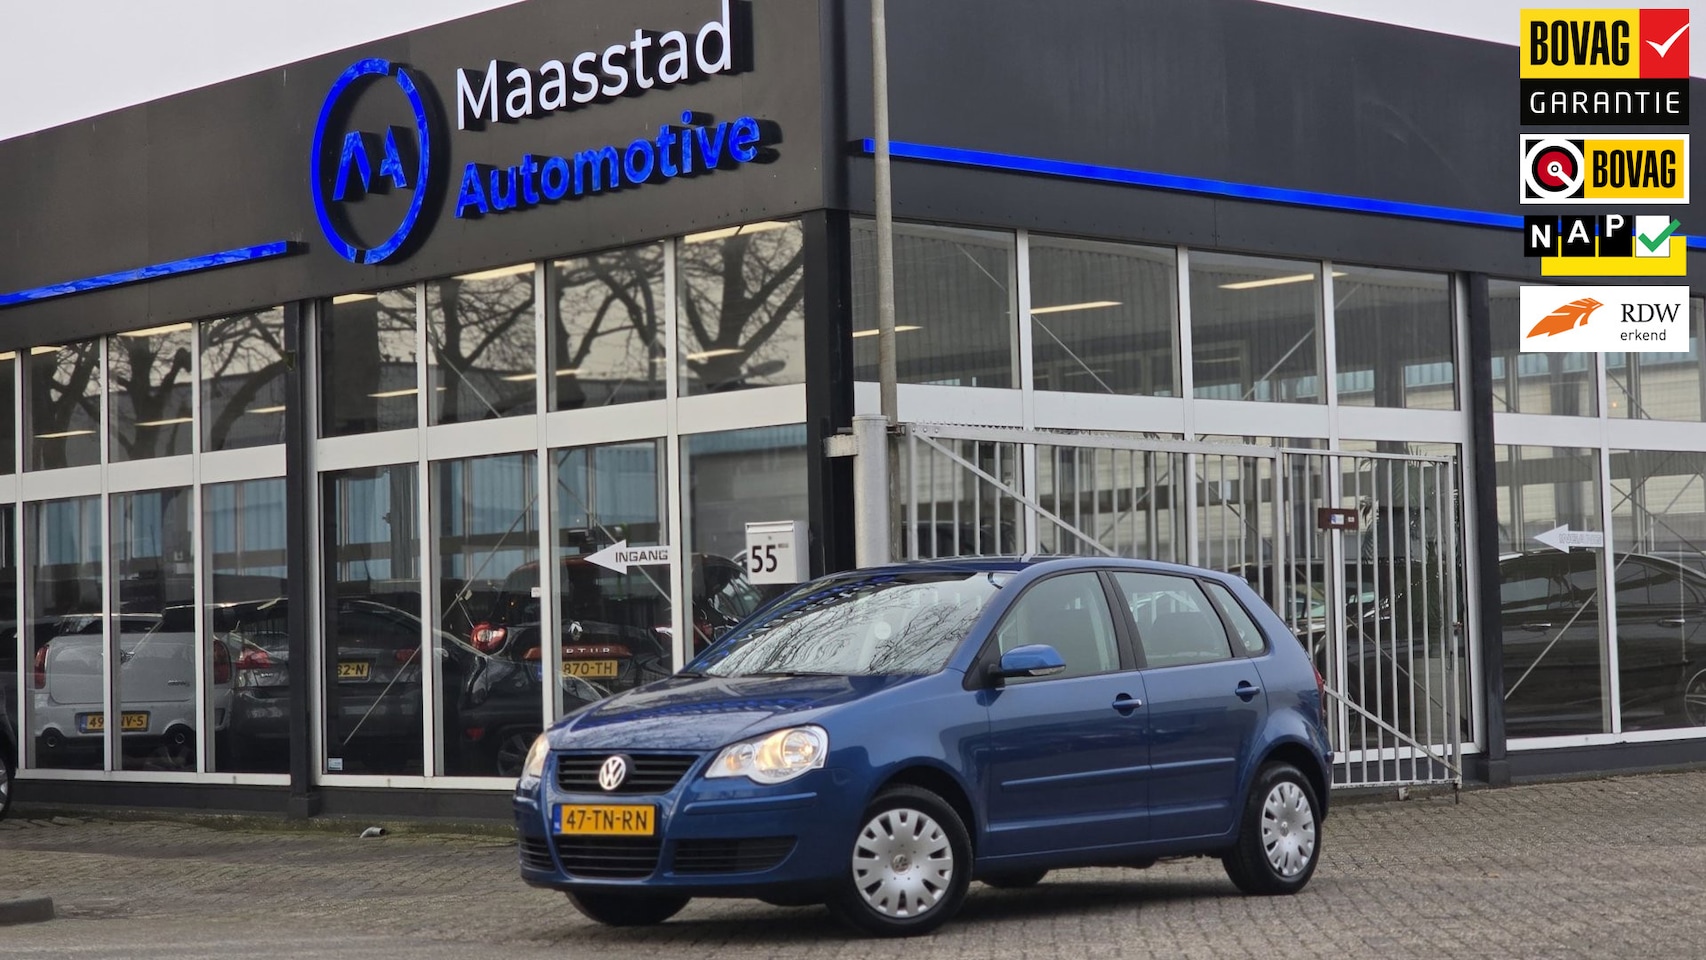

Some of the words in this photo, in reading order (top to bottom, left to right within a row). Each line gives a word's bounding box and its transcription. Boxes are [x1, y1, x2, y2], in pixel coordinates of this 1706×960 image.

[457, 0, 731, 130] Maasstad
[454, 109, 760, 219] Automotive
[615, 550, 668, 563] INGANG
[751, 545, 777, 573] 55
[566, 809, 648, 831] 47-TN-RN
